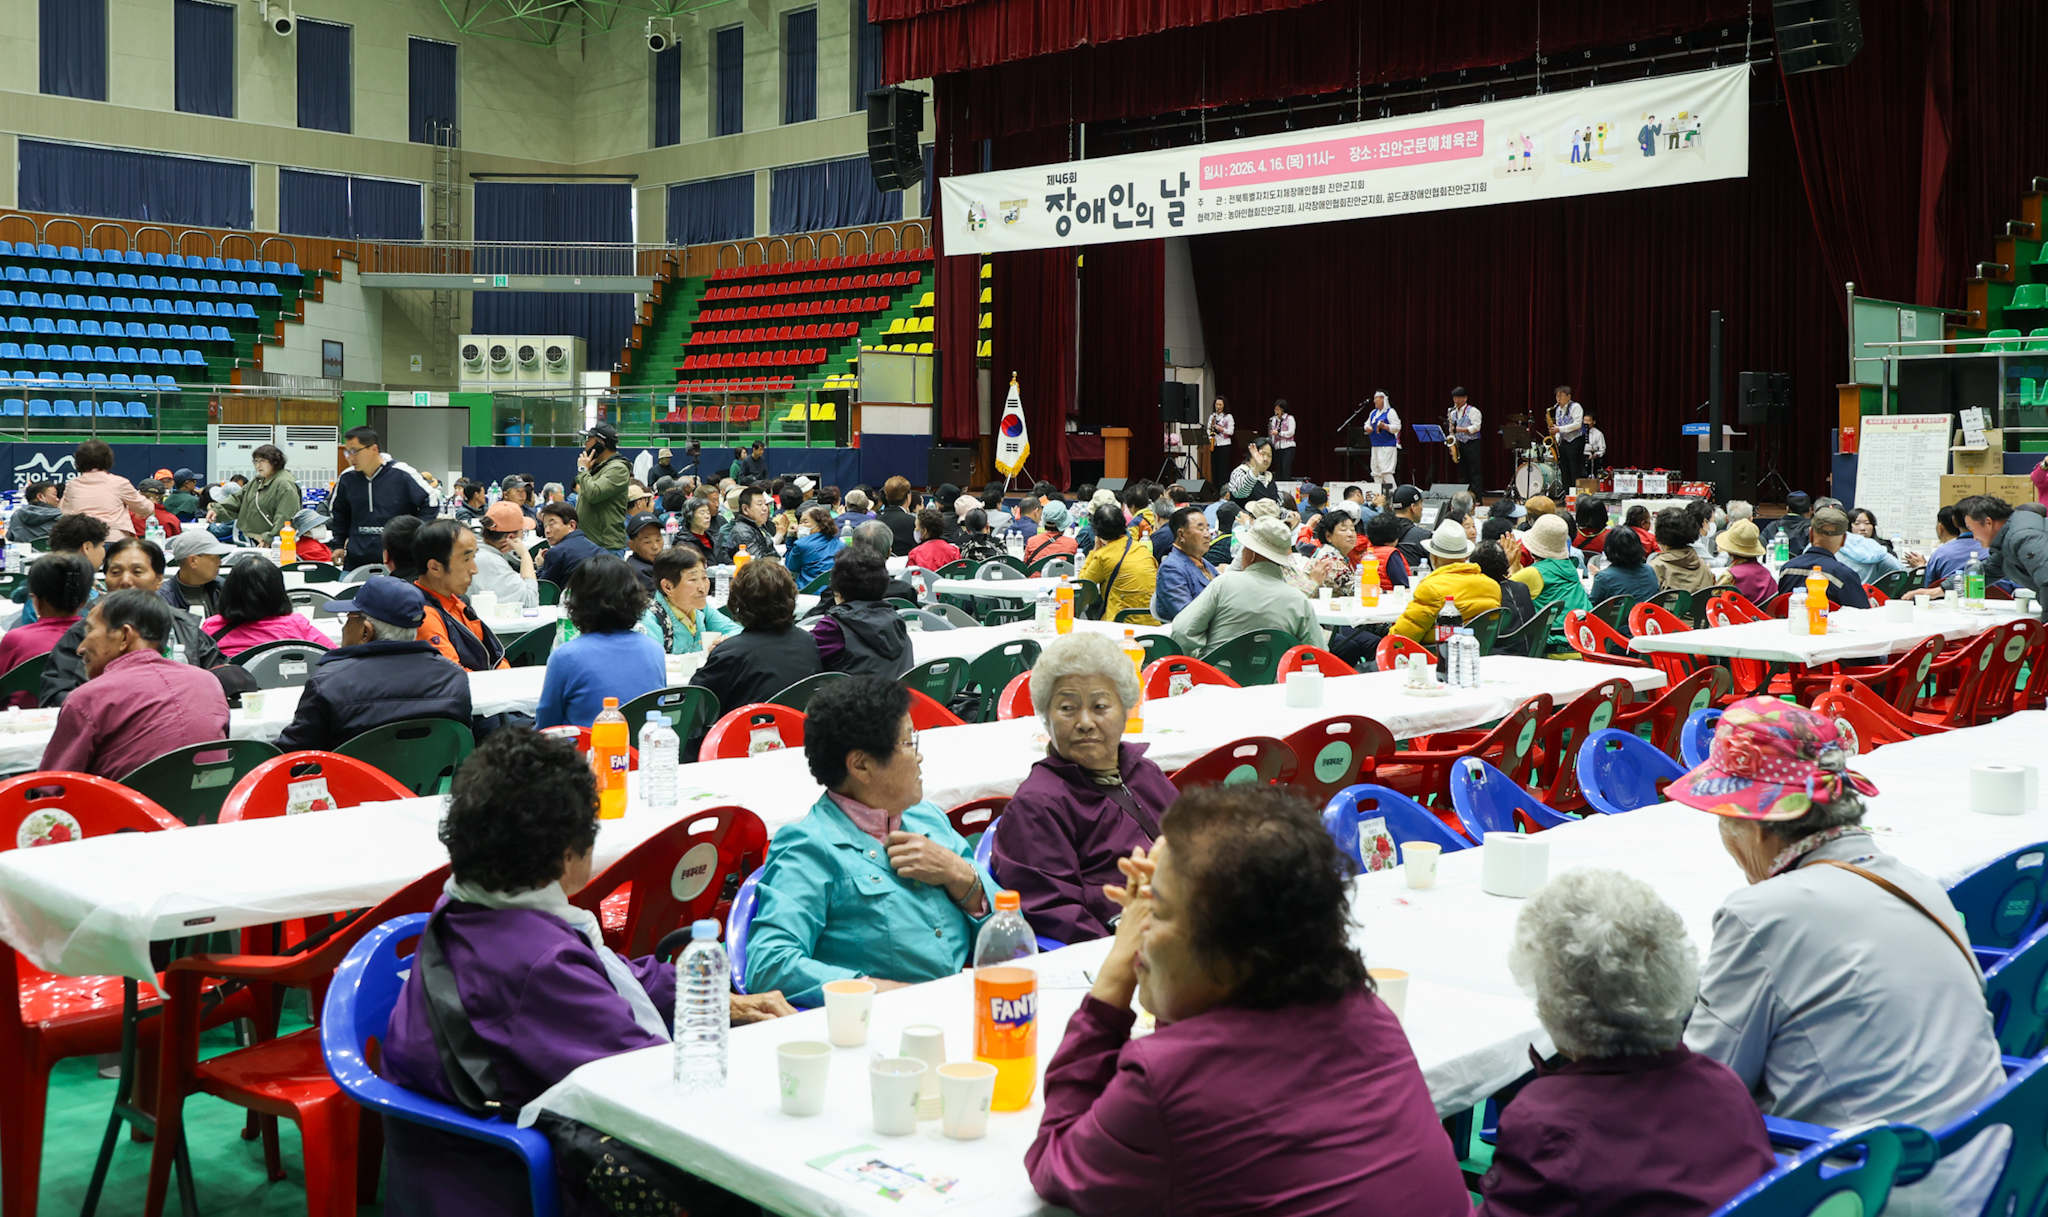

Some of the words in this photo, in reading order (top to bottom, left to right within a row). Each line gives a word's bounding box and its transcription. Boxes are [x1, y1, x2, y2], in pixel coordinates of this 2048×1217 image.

[1203, 164, 1223, 180] 일시
[1229, 161, 1256, 176] 2026.
[1257, 159, 1267, 173] 4.
[1270, 157, 1285, 171] 16.
[1286, 153, 1304, 170] (목)
[1306, 150, 1335, 166] 11시~
[1349, 145, 1372, 162] 장소
[1379, 130, 1479, 159] 진안군문예체육관
[1046, 172, 1077, 185] 제46회
[1328, 180, 1365, 193] 진안군지회
[1045, 182, 1154, 237] 장애인의
[1160, 172, 1190, 227] 날
[1197, 211, 1223, 223] 협력기관
